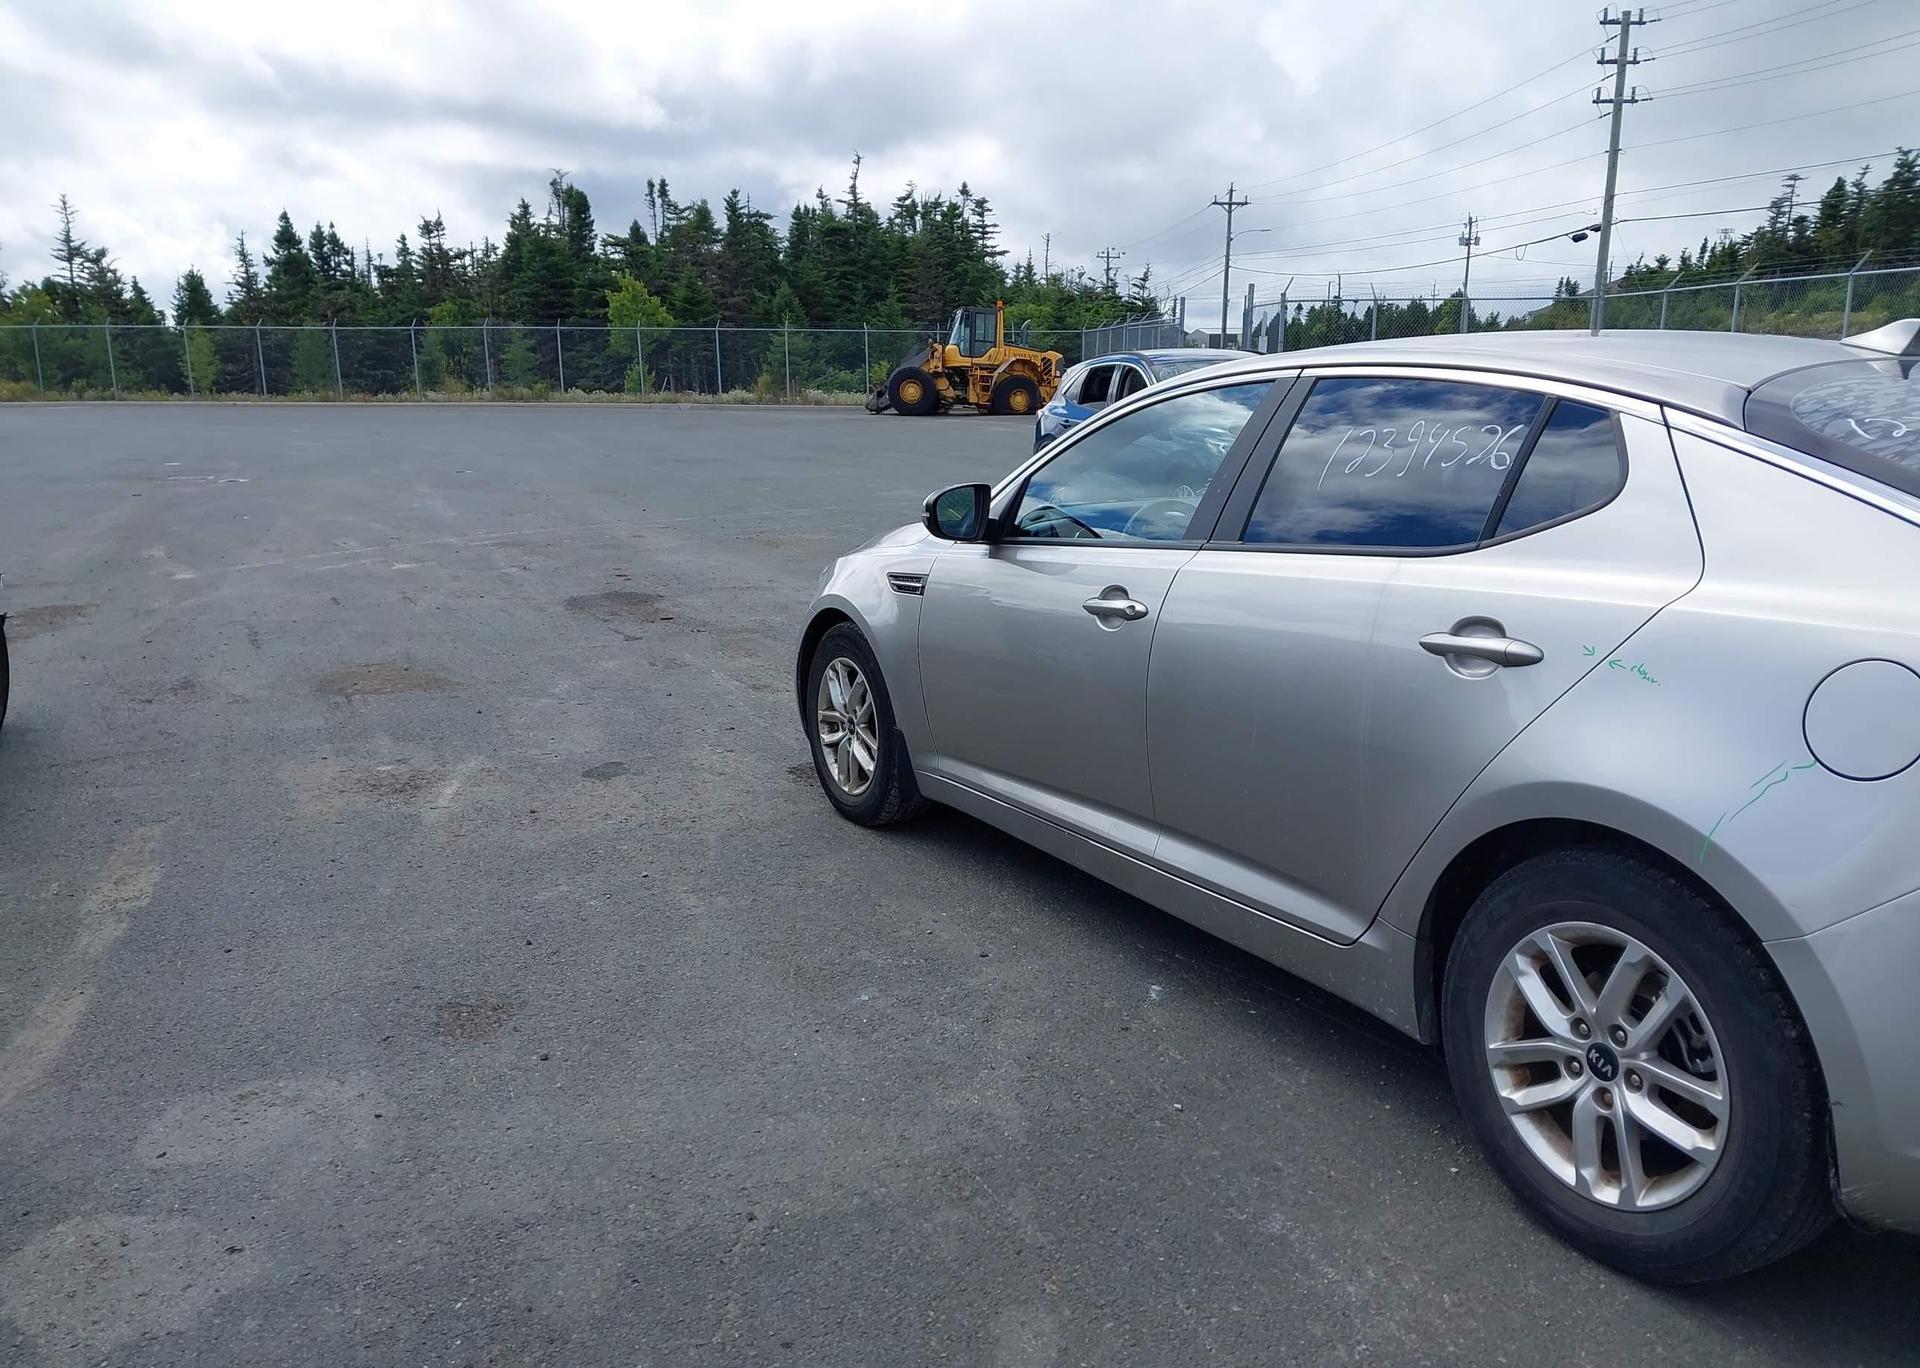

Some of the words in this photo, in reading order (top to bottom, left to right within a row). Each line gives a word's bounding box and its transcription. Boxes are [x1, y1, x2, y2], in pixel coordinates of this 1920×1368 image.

[1012, 352, 1039, 360] VOLVO
[1847, 416, 1920, 440] 12
[1317, 420, 1525, 490] 12394526
[1589, 1047, 1613, 1078] KIA
